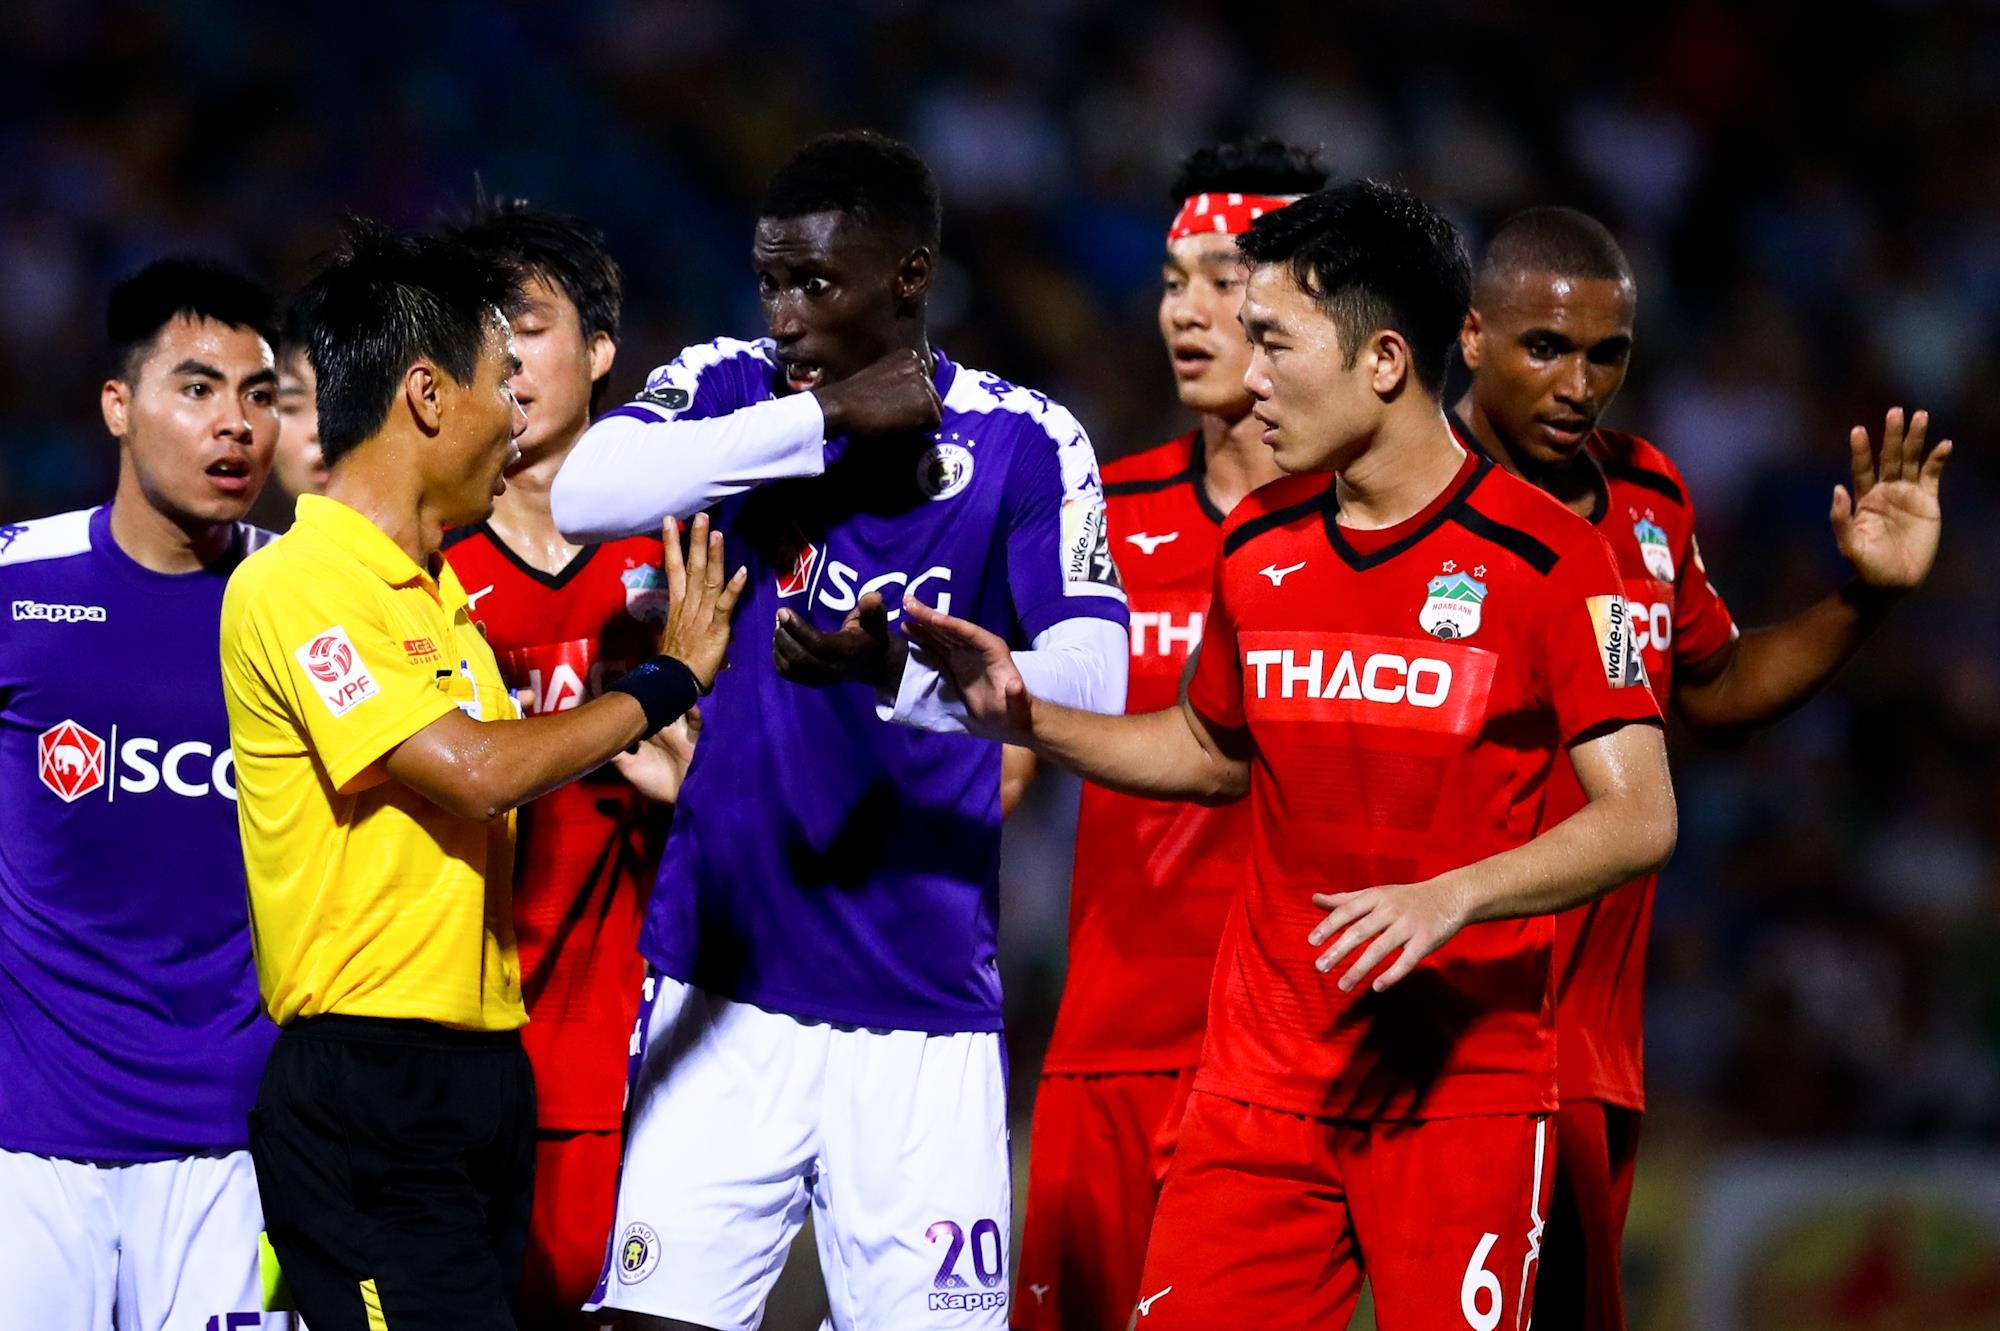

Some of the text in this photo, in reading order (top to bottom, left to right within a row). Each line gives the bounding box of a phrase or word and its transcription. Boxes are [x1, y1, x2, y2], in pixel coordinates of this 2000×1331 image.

[12, 600, 106, 622] Kappa
[1130, 611, 1203, 656] TH
[1605, 603, 1623, 678] wake-up
[328, 675, 370, 707] VPF
[1246, 649, 1453, 708] THACO
[625, 1226, 655, 1244] HANOI
[925, 1218, 1003, 1289] 20
[928, 1291, 1007, 1311] Kappa
[1461, 1232, 1503, 1331] 6
